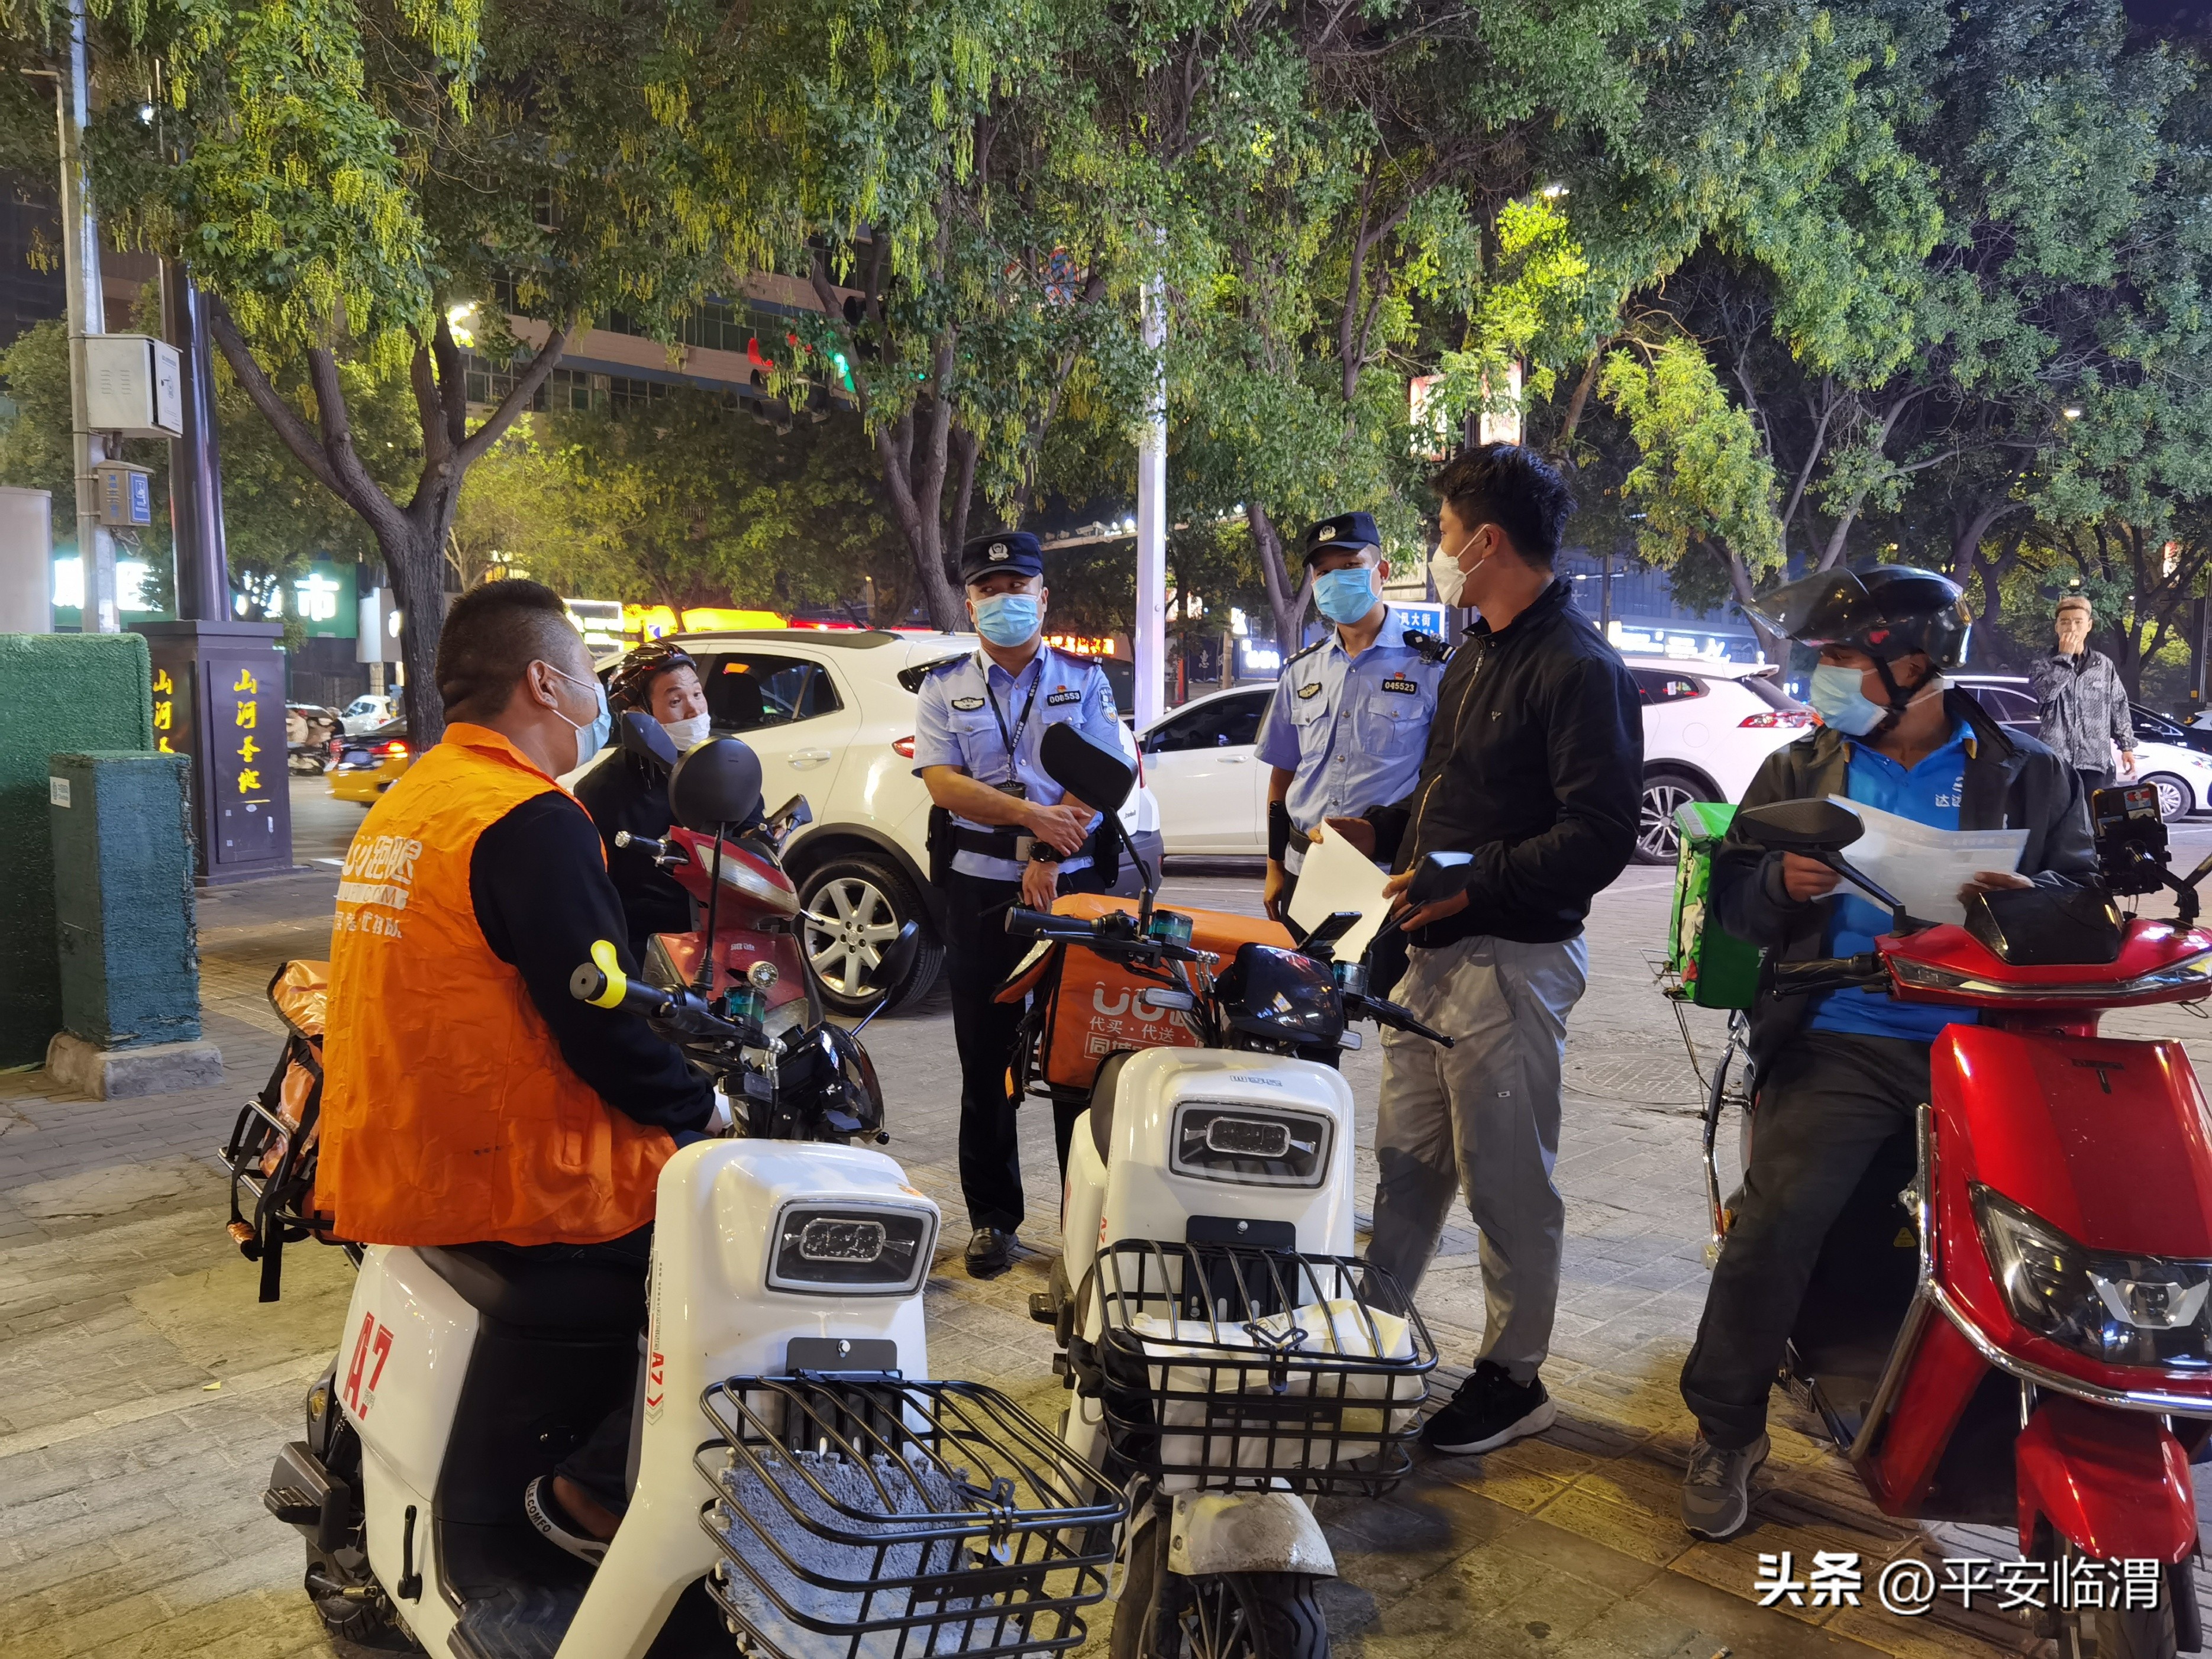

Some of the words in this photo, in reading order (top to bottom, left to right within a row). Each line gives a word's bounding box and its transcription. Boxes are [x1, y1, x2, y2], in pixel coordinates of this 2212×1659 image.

[1384, 681, 1415, 692] 045523
[343, 1311, 394, 1421] A7
[651, 1352, 664, 1386] A7
